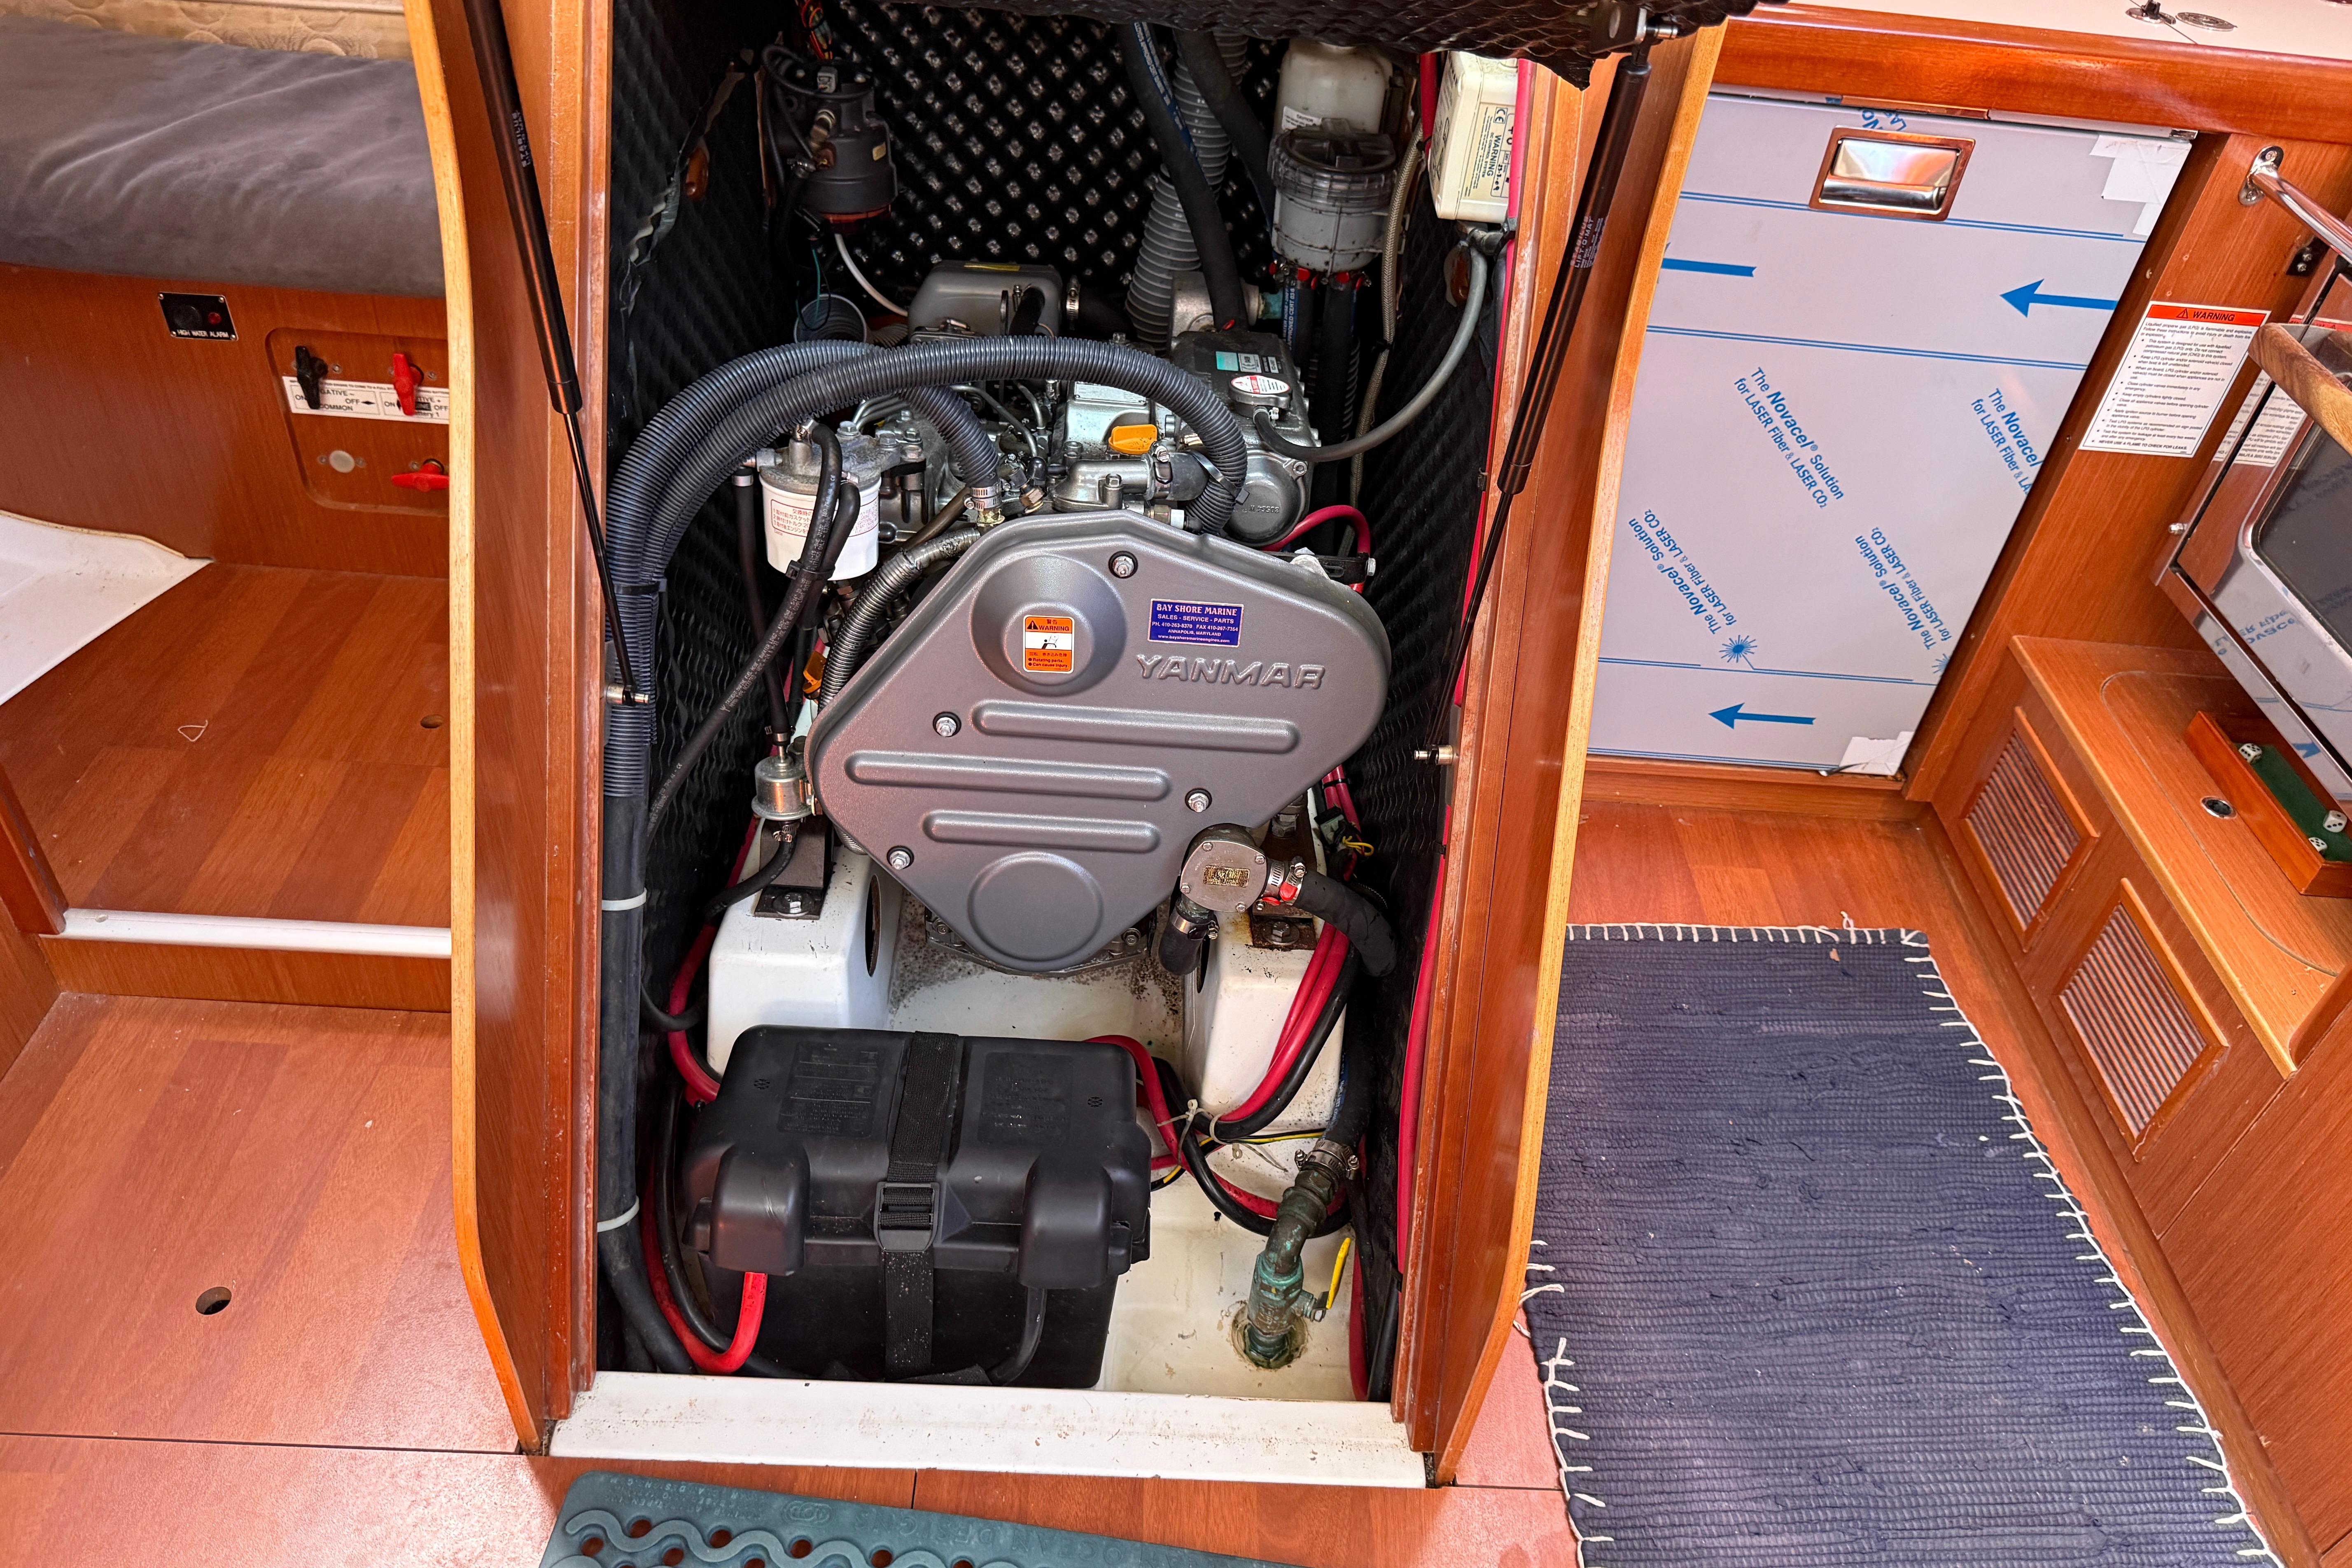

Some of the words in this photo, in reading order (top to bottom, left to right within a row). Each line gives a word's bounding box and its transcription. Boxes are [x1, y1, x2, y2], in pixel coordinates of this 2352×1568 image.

[1495, 109, 1505, 122] CE
[1487, 135, 1502, 176] WARNING
[2193, 311, 2235, 322] WARNING
[1988, 388, 2006, 413] The
[1734, 378, 1750, 394] for
[1745, 393, 1773, 429] LASER
[1767, 426, 1790, 453] Fiber
[1785, 452, 1794, 460] &
[1790, 457, 1818, 491] LASER
[1751, 366, 1770, 392] The
[1810, 454, 1844, 499] Solution
[1970, 398, 1987, 415] for
[1980, 413, 2006, 448] LASER
[2000, 446, 2020, 471] Fiber
[2014, 471, 2023, 479] &
[1628, 518, 1664, 562] Solution
[1655, 527, 1683, 558] LASER
[1680, 555, 1688, 563] &
[1855, 535, 1887, 578] Solution
[1881, 544, 1906, 575] LASER
[1684, 563, 1706, 586] Fiber
[1700, 584, 1727, 613] LASER
[1905, 579, 1925, 602] Fiber
[1175, 605, 1203, 614] SHORE
[1204, 607, 1237, 616] MARINE
[1722, 612, 1737, 626] for
[1919, 600, 1944, 629] LASER
[1704, 614, 1722, 635] The
[1939, 628, 1952, 641] for
[1920, 630, 1936, 650] The
[1136, 654, 1325, 690] YANMAR
